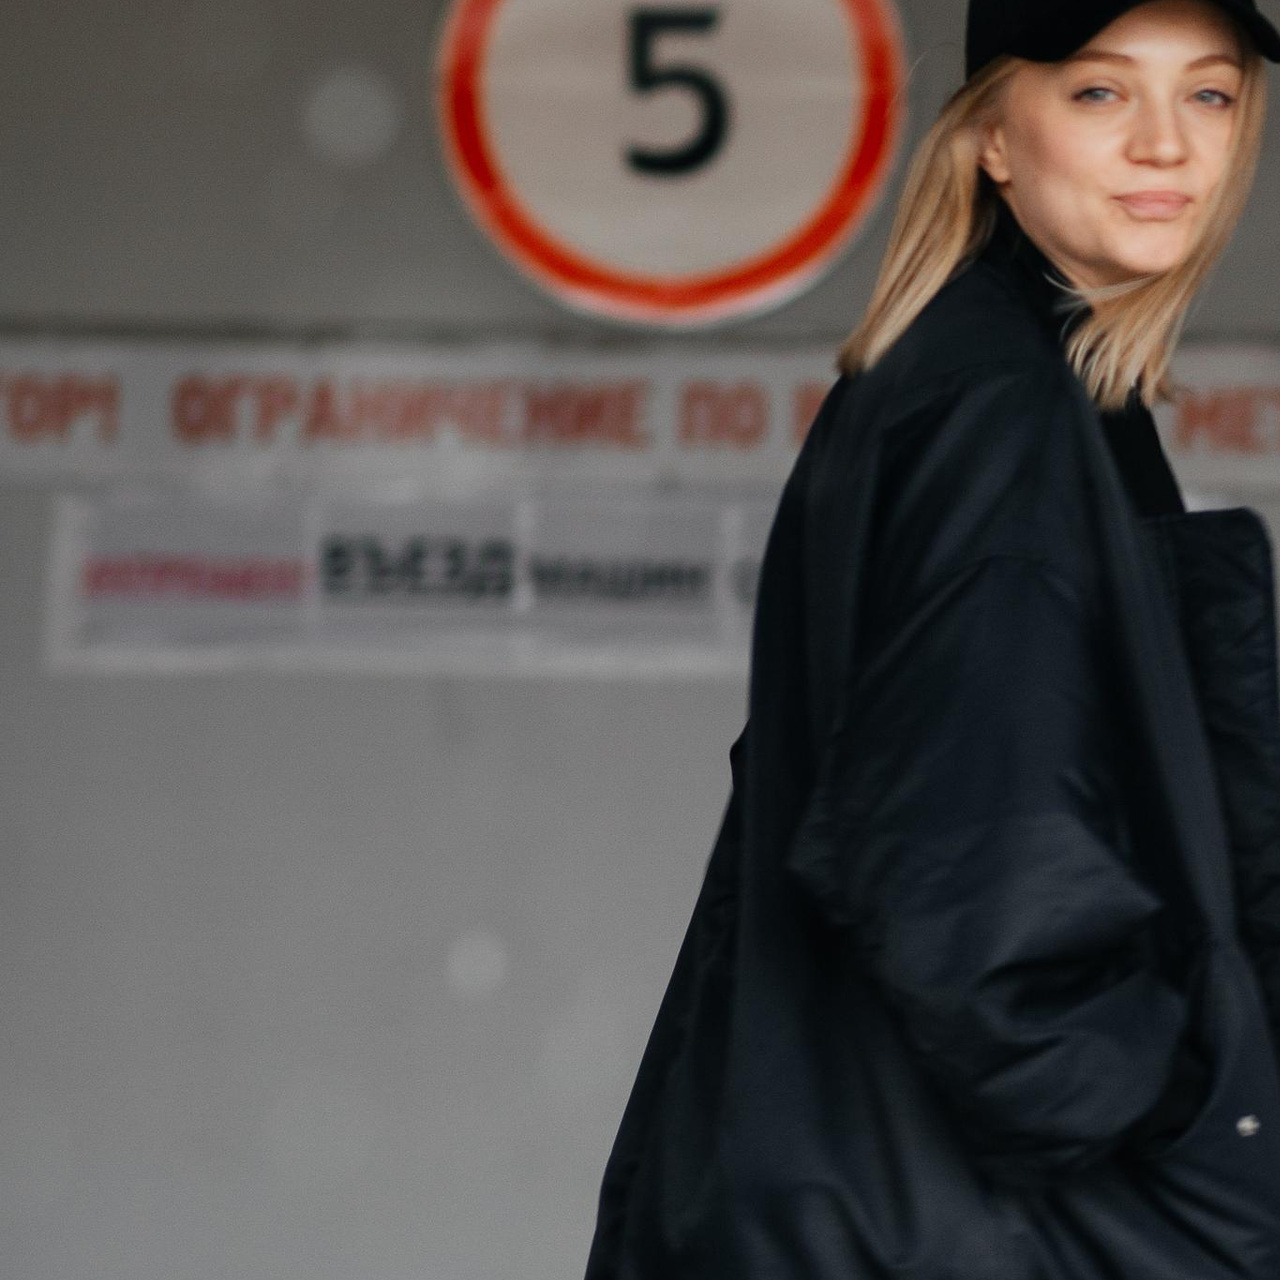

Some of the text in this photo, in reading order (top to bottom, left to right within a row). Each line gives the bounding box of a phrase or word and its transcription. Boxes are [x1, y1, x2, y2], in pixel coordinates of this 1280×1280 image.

[622, 4, 732, 180] 5
[170, 373, 652, 448] ОГРАНИЧЕНИЕ
[679, 379, 770, 450] ПО
